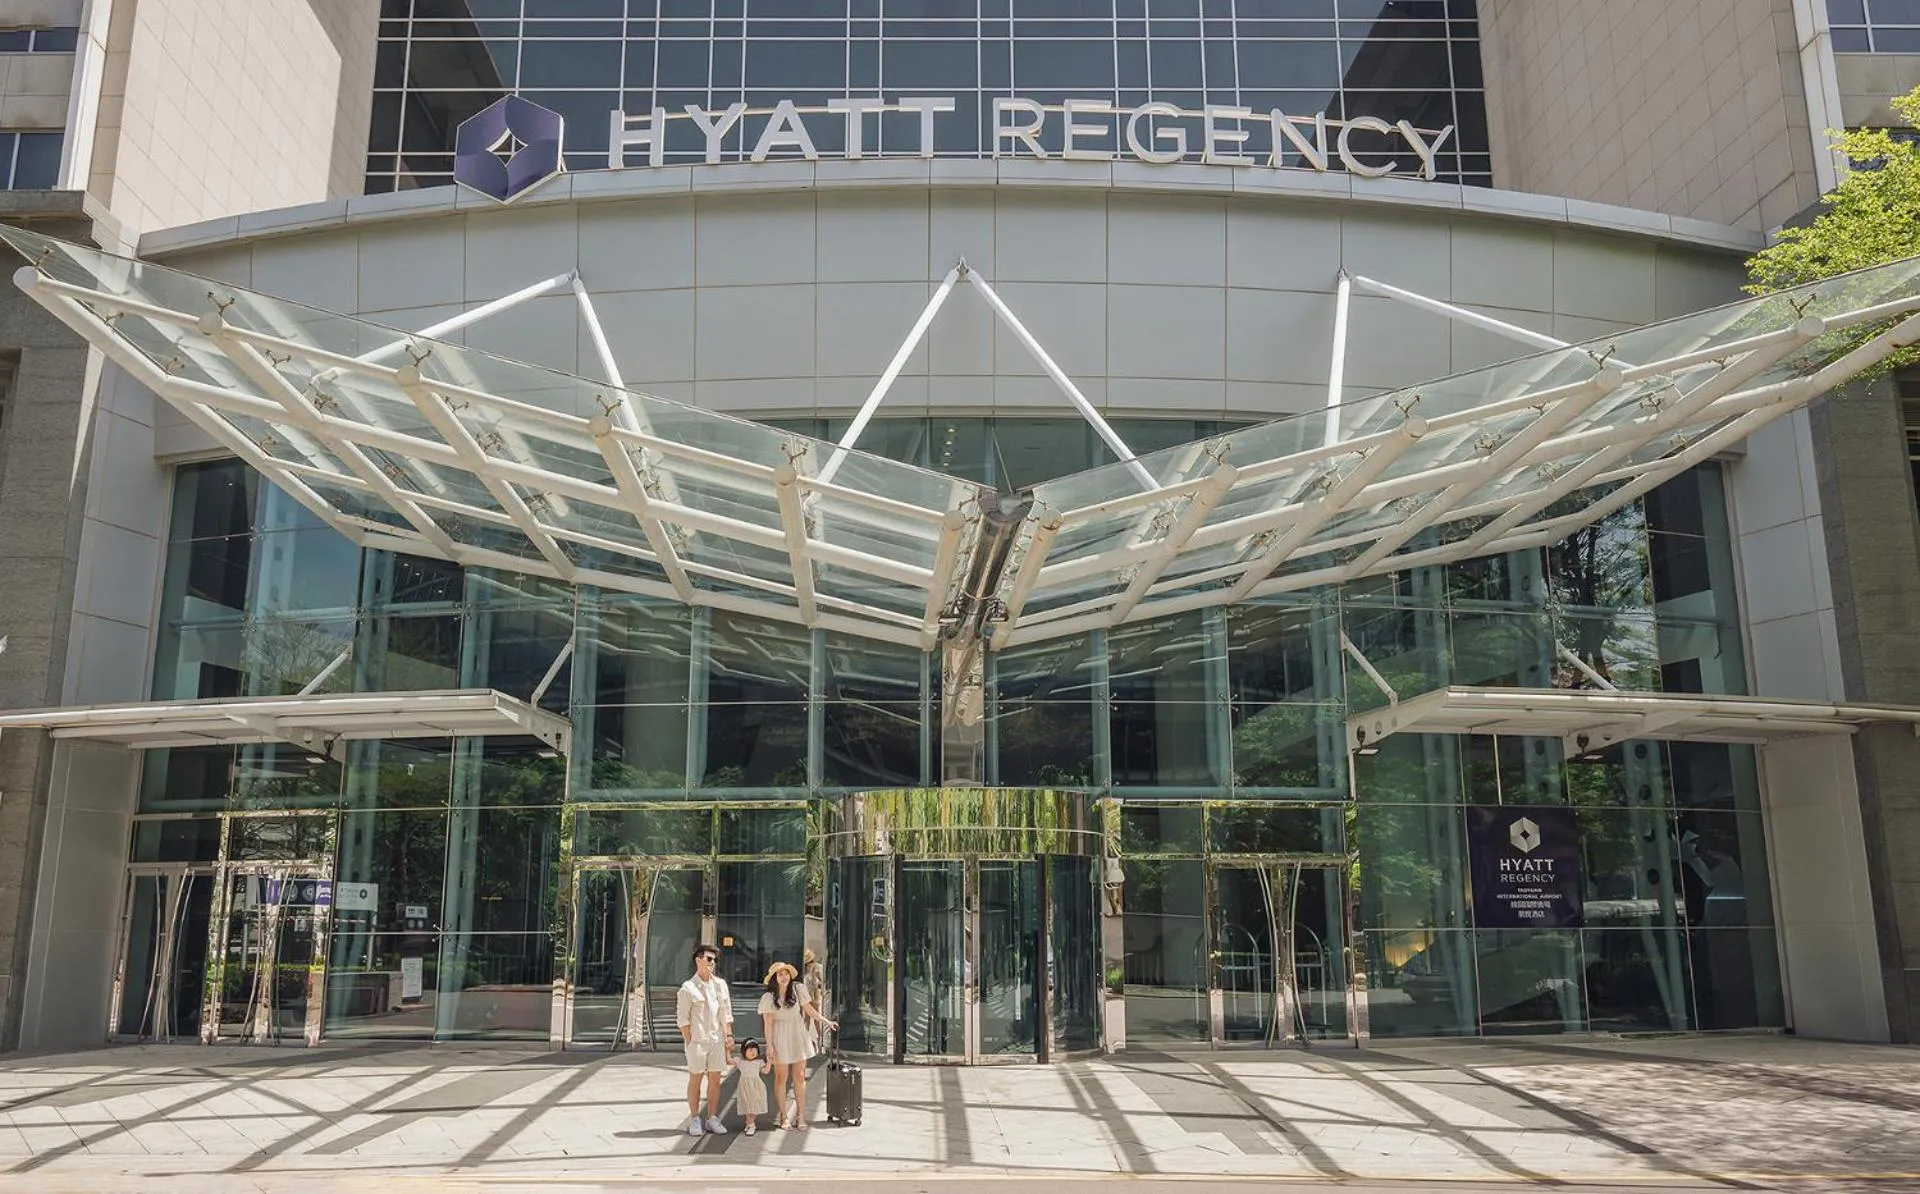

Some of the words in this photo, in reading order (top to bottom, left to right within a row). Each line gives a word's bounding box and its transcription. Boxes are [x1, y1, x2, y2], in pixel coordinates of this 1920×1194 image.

[608, 97, 955, 169] HYATT
[992, 98, 1455, 181] REGENCY
[1500, 859, 1554, 871] HYATT
[1501, 874, 1555, 882] REGENCY
